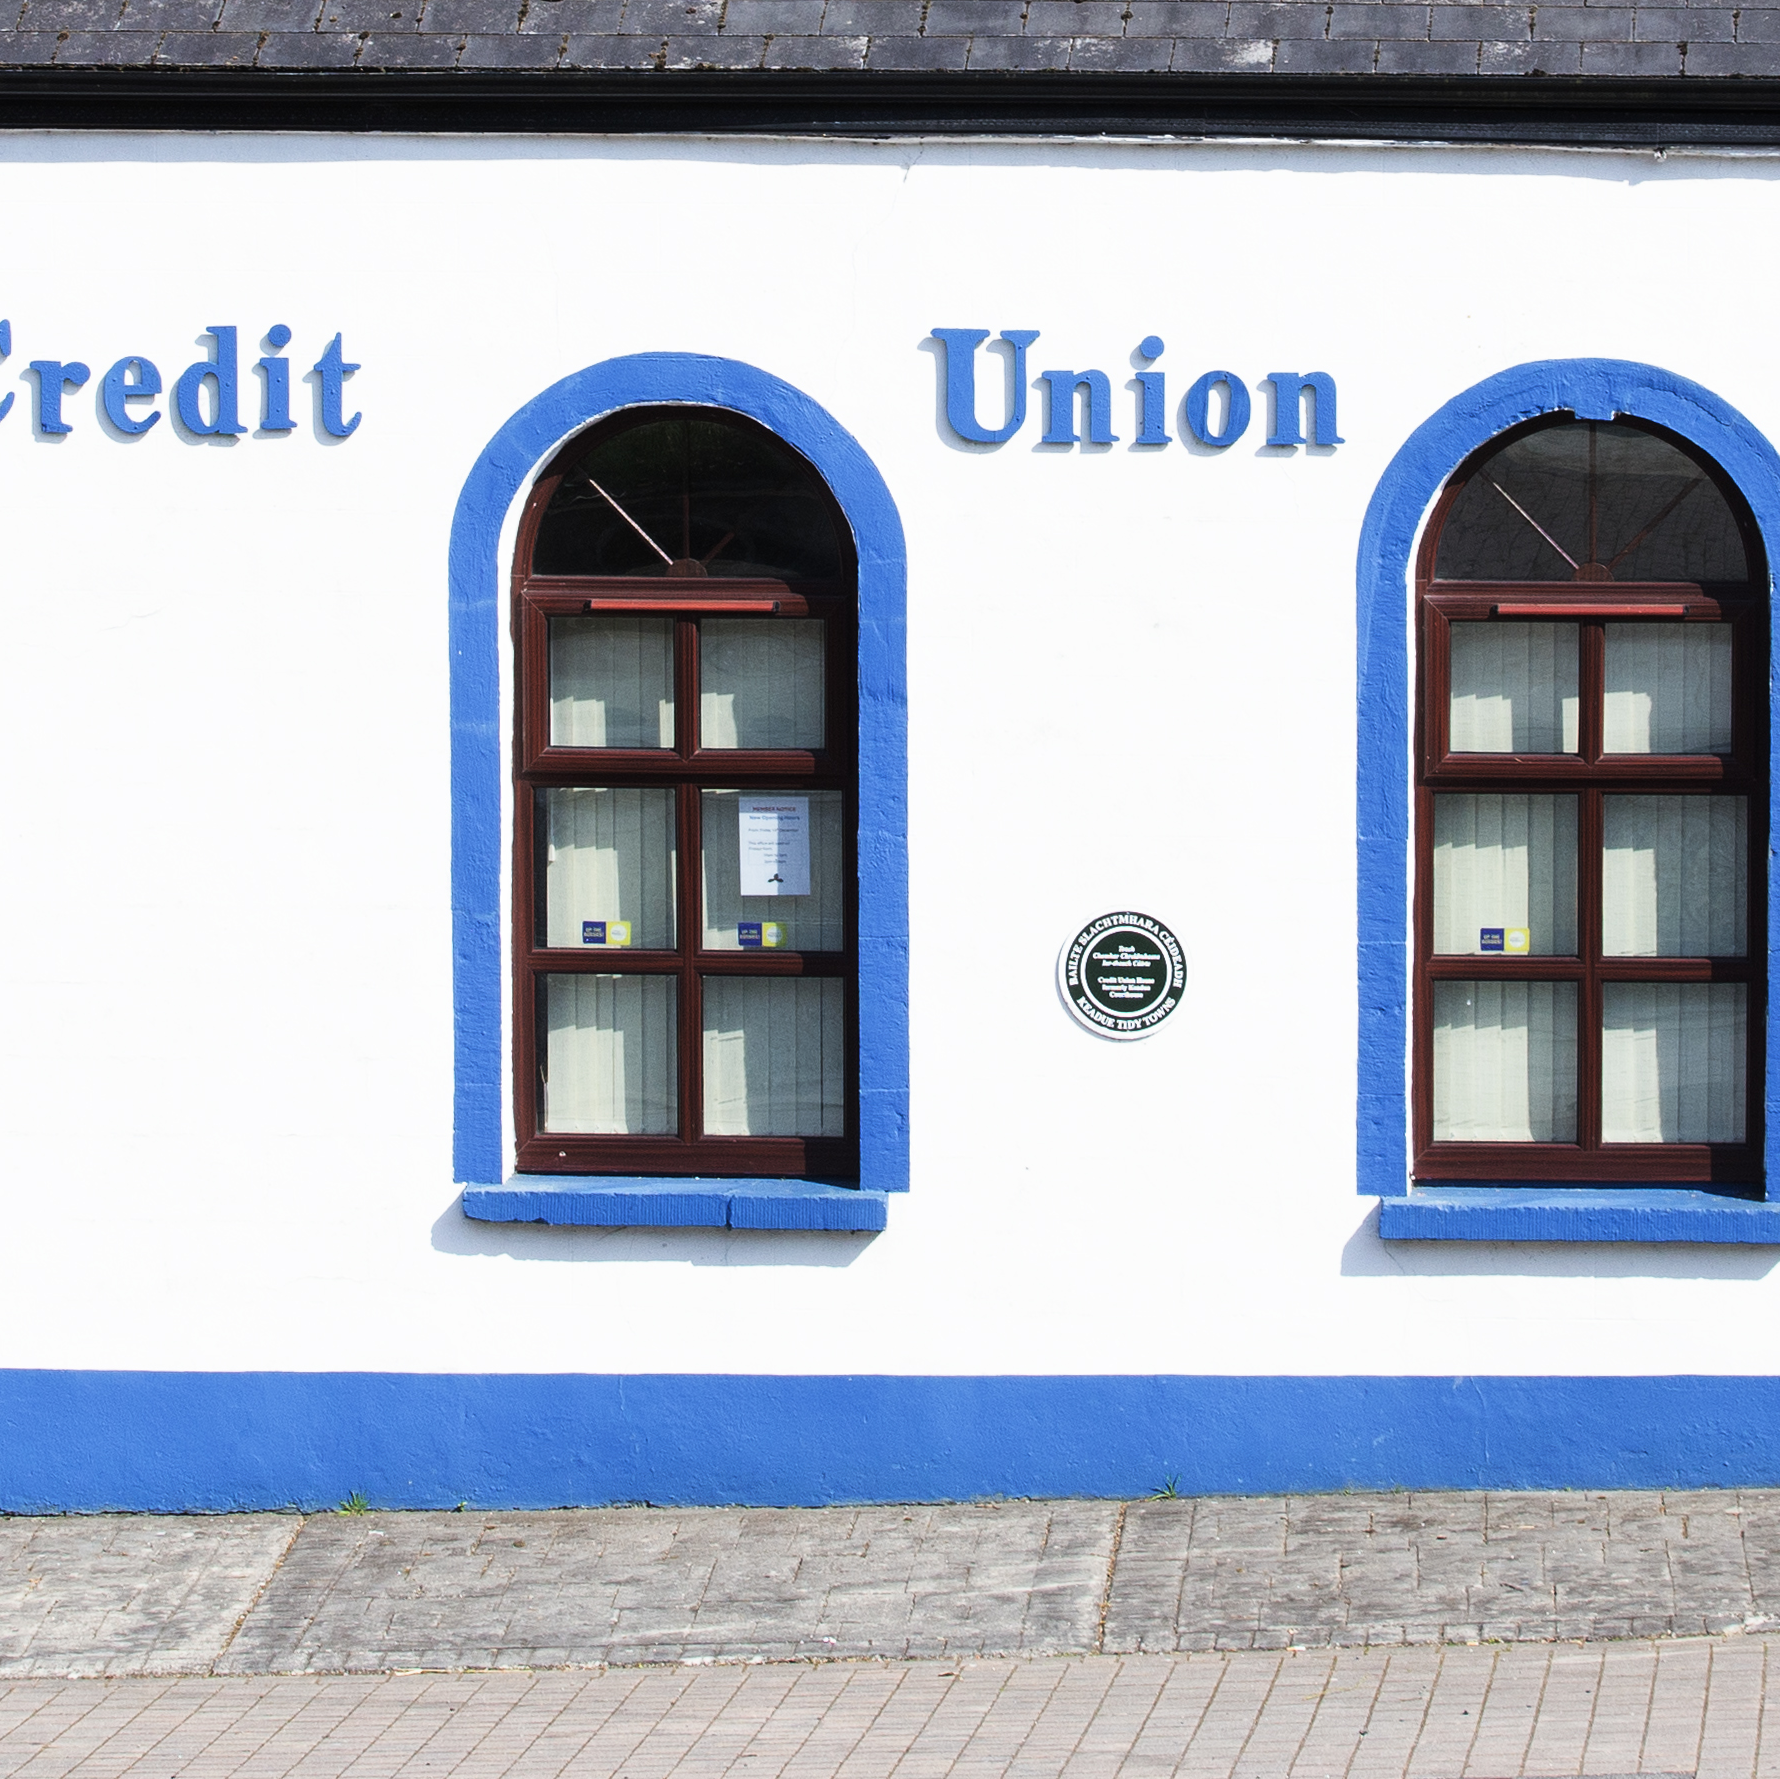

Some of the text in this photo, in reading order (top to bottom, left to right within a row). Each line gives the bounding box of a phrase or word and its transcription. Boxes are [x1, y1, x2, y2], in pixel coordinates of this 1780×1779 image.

[929, 327, 1346, 447] Union
[1068, 944, 1083, 986] BAILTE
[1076, 996, 1176, 1030] KEADUE TIDY TOWNS
